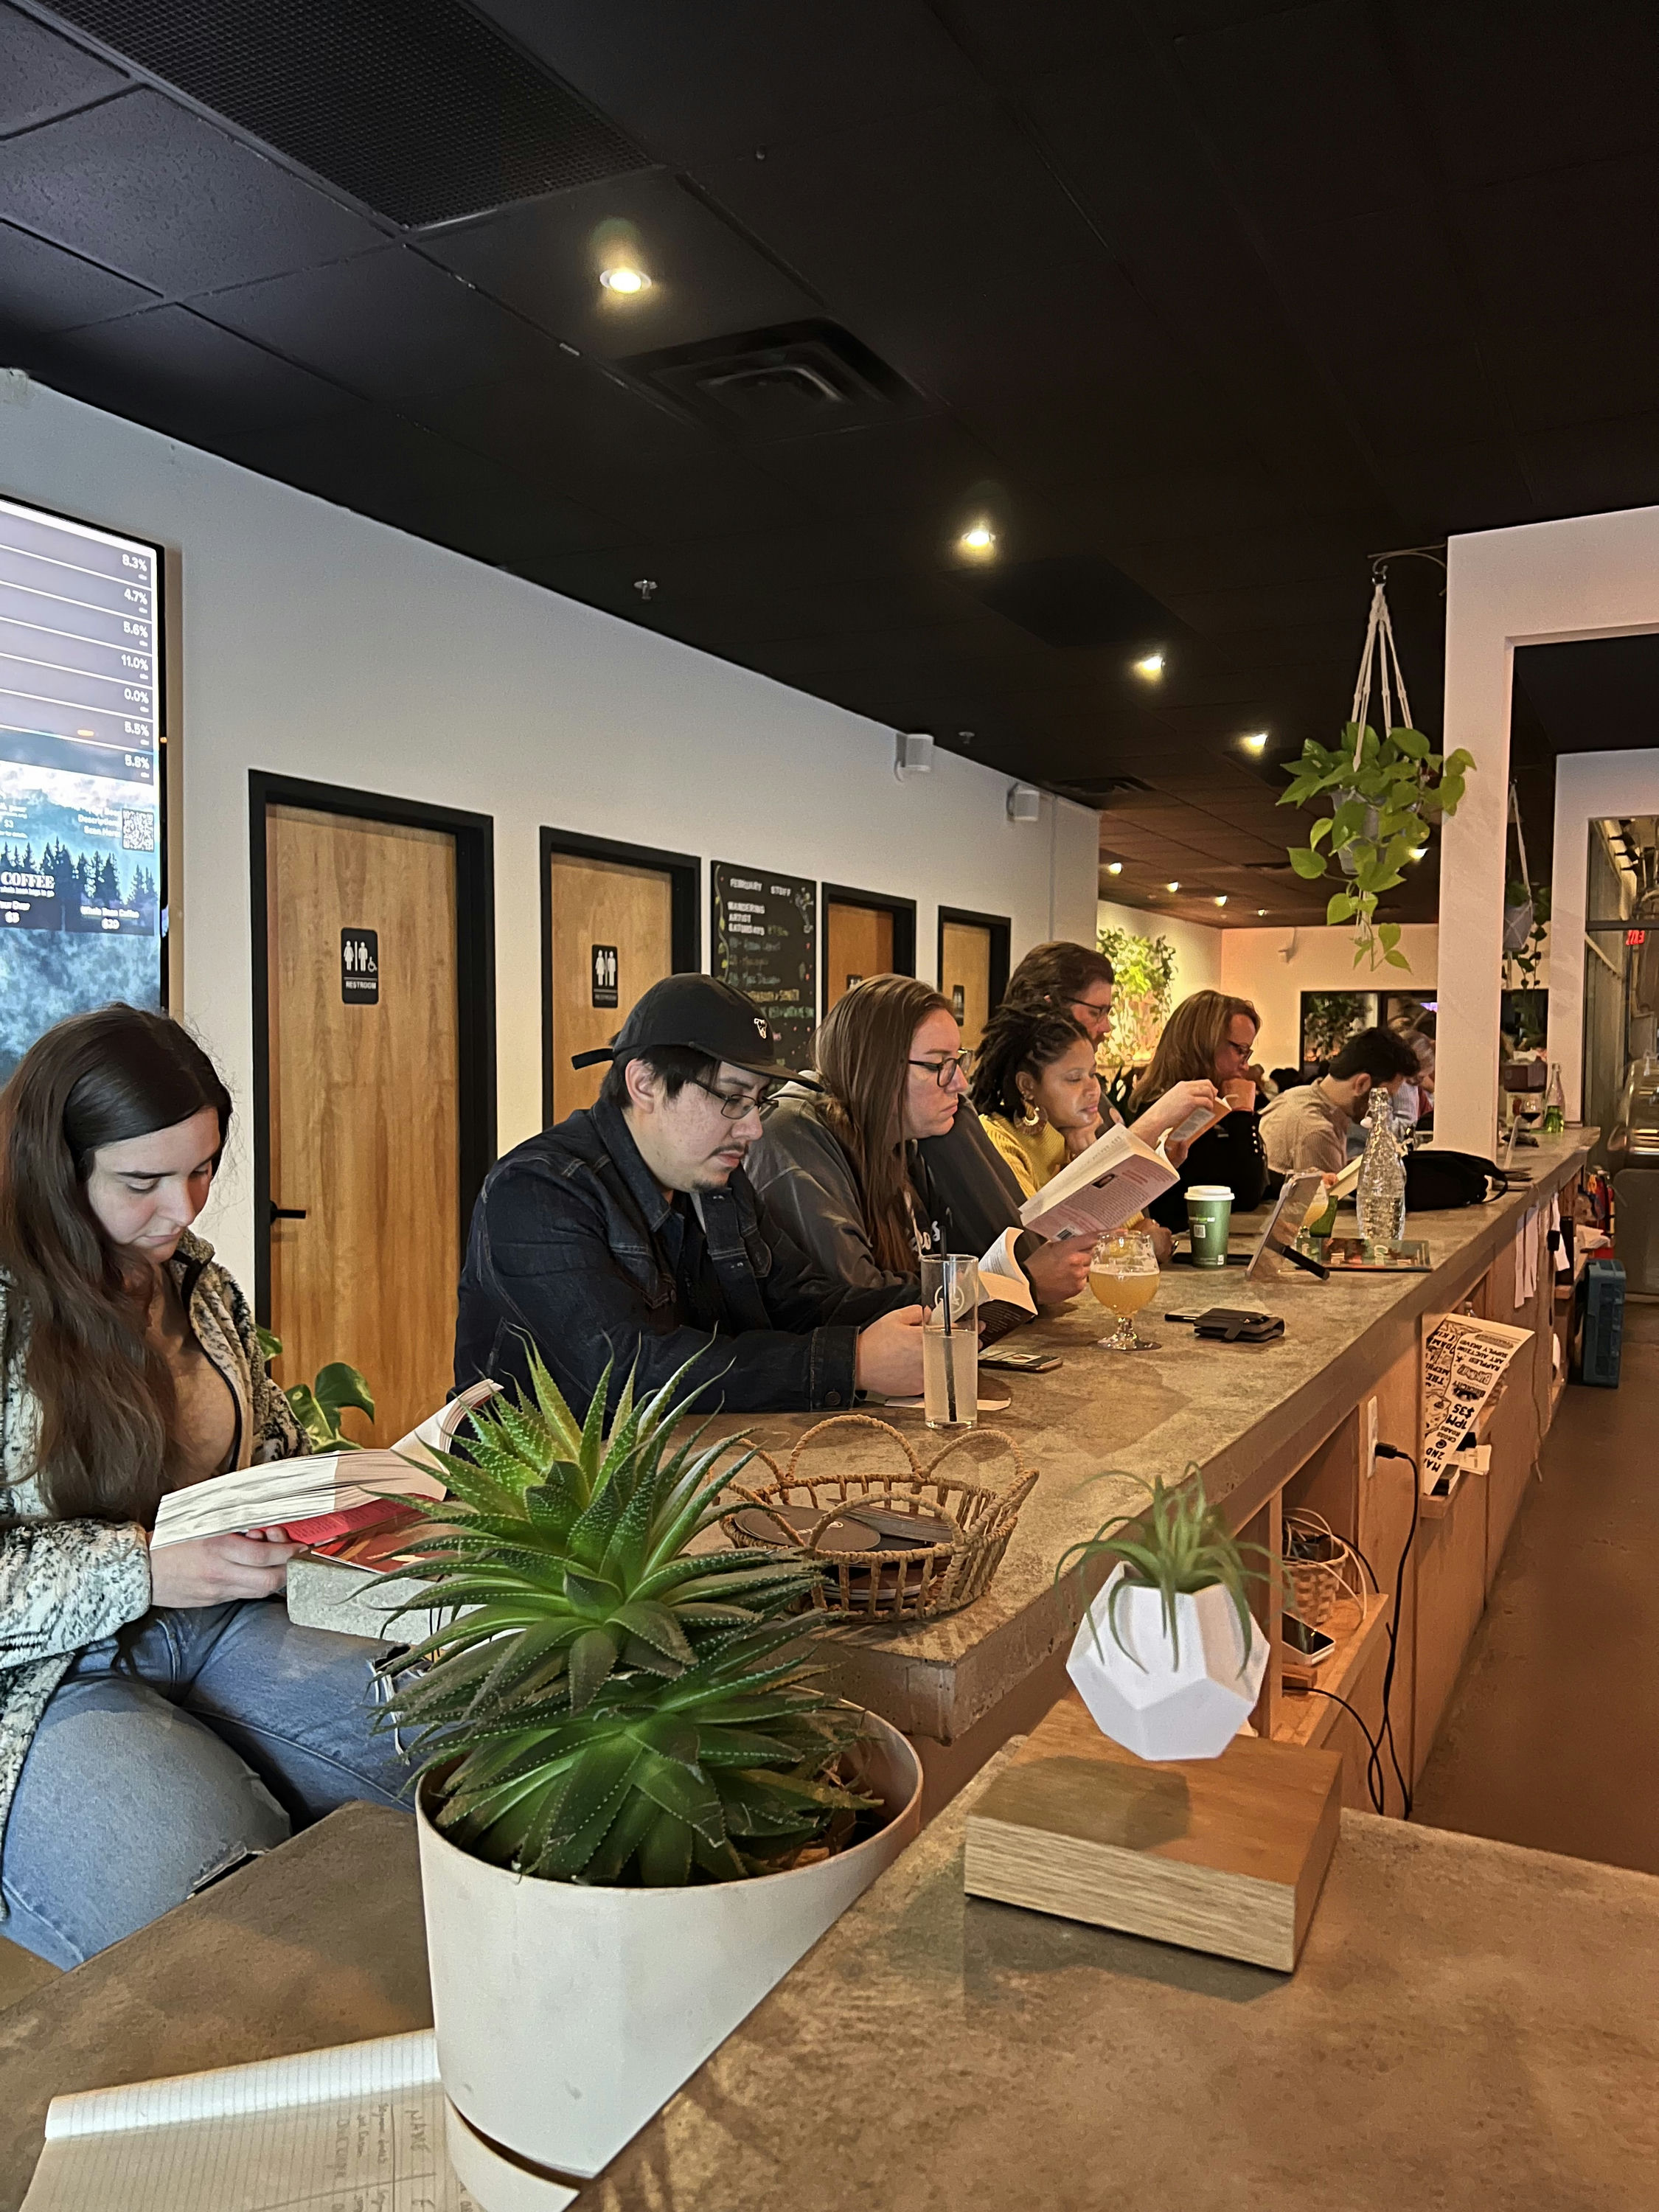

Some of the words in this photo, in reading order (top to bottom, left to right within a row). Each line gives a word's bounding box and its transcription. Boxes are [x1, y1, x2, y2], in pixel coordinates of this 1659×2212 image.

[122, 554, 147, 571] 8.3%
[124, 588, 148, 605] 4.7%
[123, 621, 149, 638] 5.6%
[121, 654, 149, 671] 11.0%
[124, 688, 150, 704] 0.0%
[124, 721, 150, 737] 5.5%
[1, 871, 56, 889] COFFEE
[345, 981, 377, 990] RESTROOM
[1482, 1347, 1509, 1358] SUPPLY
[1489, 1354, 1505, 1364] ART
[1425, 1372, 1444, 1385] THE
[1452, 1404, 1475, 1419] $35
[1445, 1414, 1468, 1430] 1PM
[1436, 1431, 1457, 1443] CROSS
[1440, 1426, 1461, 1437] ROADS
[1436, 1439, 1447, 1449] @
[1425, 1447, 1445, 1460] 2ND
